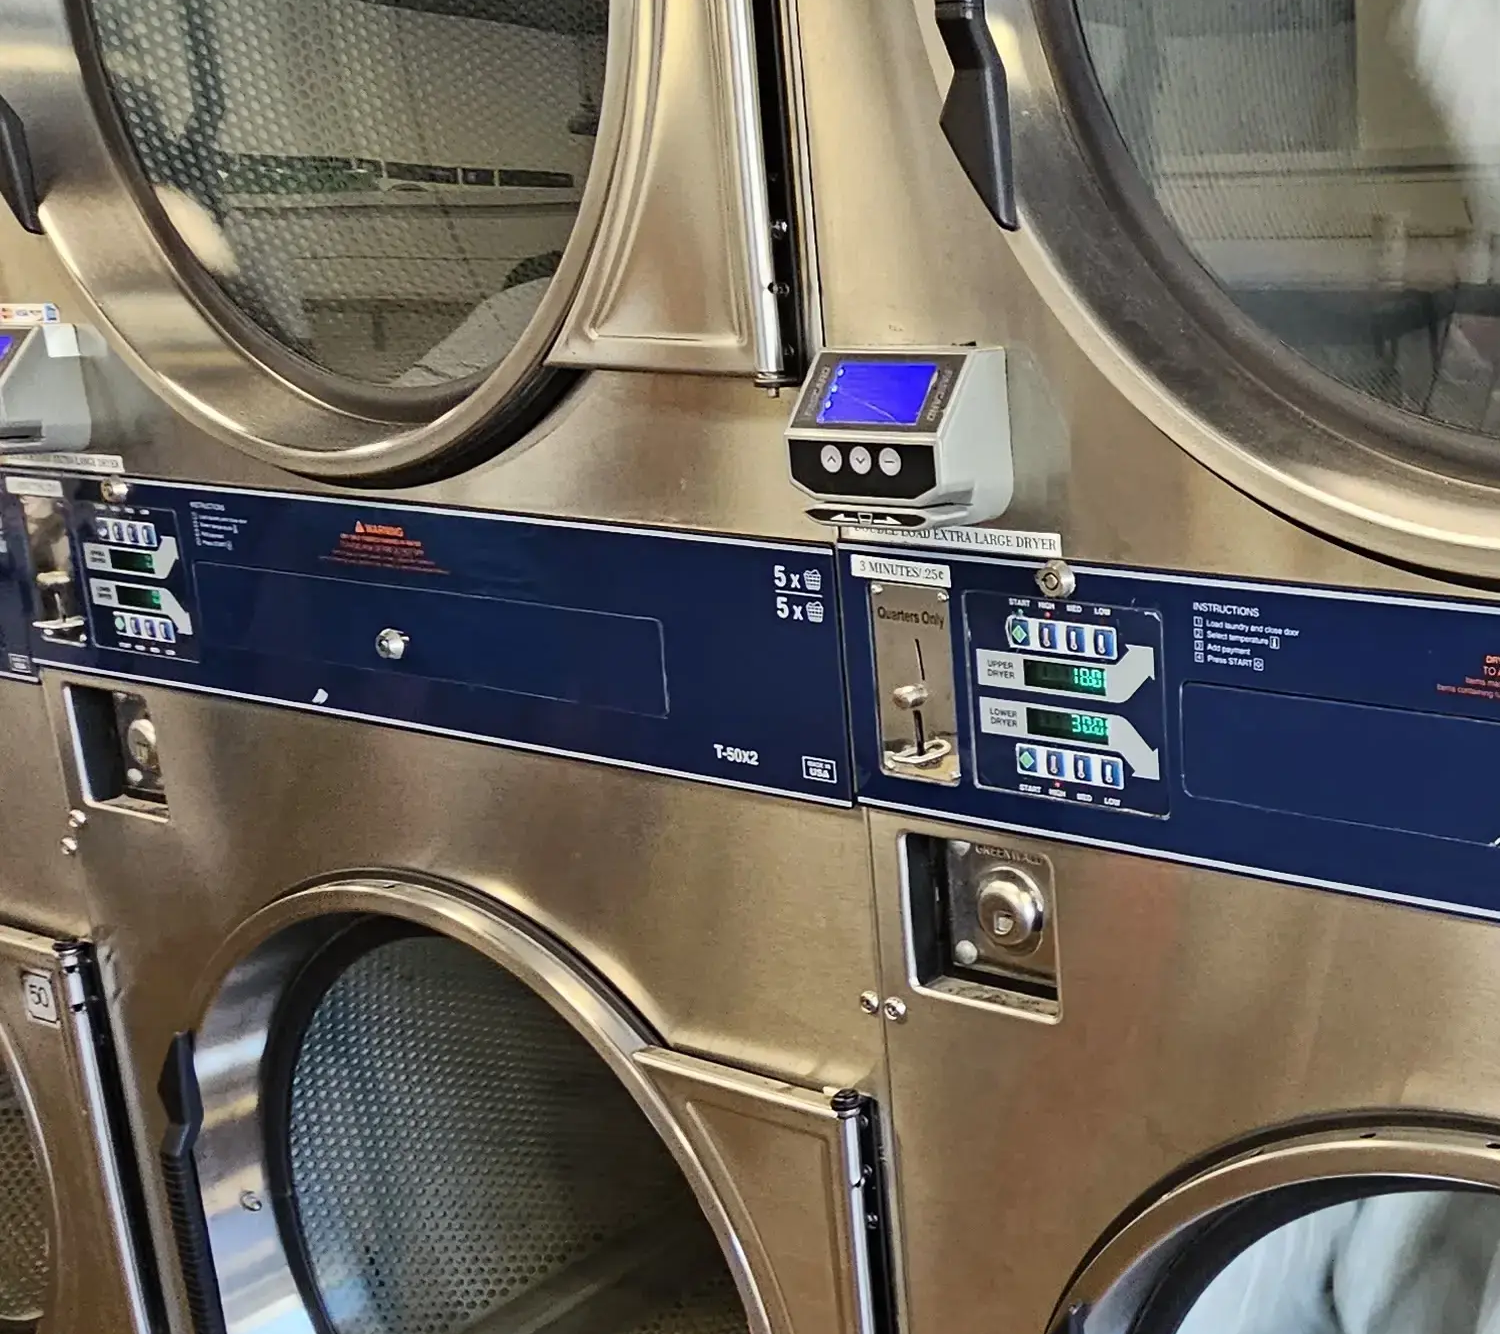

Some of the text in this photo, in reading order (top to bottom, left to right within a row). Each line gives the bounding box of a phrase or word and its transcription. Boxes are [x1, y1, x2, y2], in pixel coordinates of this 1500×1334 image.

[933, 527, 972, 544] EXTRA
[975, 532, 1012, 547] LARGE
[1016, 537, 1056, 551] DRYER
[859, 560, 866, 571] 3
[773, 565, 801, 589] 5 x
[776, 596, 804, 620] 5 x
[1009, 598, 1111, 616] START HIGH MED LOW
[1192, 602, 1260, 617] INSTRUCTIONS
[877, 606, 944, 629] Quarters Only
[1206, 619, 1223, 628] Load
[1225, 622, 1249, 632] laundry
[1250, 625, 1263, 633] and
[1265, 626, 1282, 635] close
[1284, 628, 1300, 637] door
[1206, 630, 1228, 640] Select
[1229, 634, 1269, 645] temperature
[1207, 643, 1221, 652] Add
[1222, 646, 1251, 656] payment
[987, 659, 1013, 670] UPPER
[1207, 654, 1227, 664] Press
[1228, 657, 1253, 667] START
[987, 668, 1015, 679] DRYER
[1483, 666, 1497, 676] TO
[989, 707, 1017, 718] LOWER
[990, 717, 1018, 728] DRYER
[712, 743, 760, 766] T-50X2
[809, 767, 830, 778] USA
[1018, 783, 1041, 794] START
[1103, 797, 1121, 807] LOW
[29, 984, 49, 1007] 50
